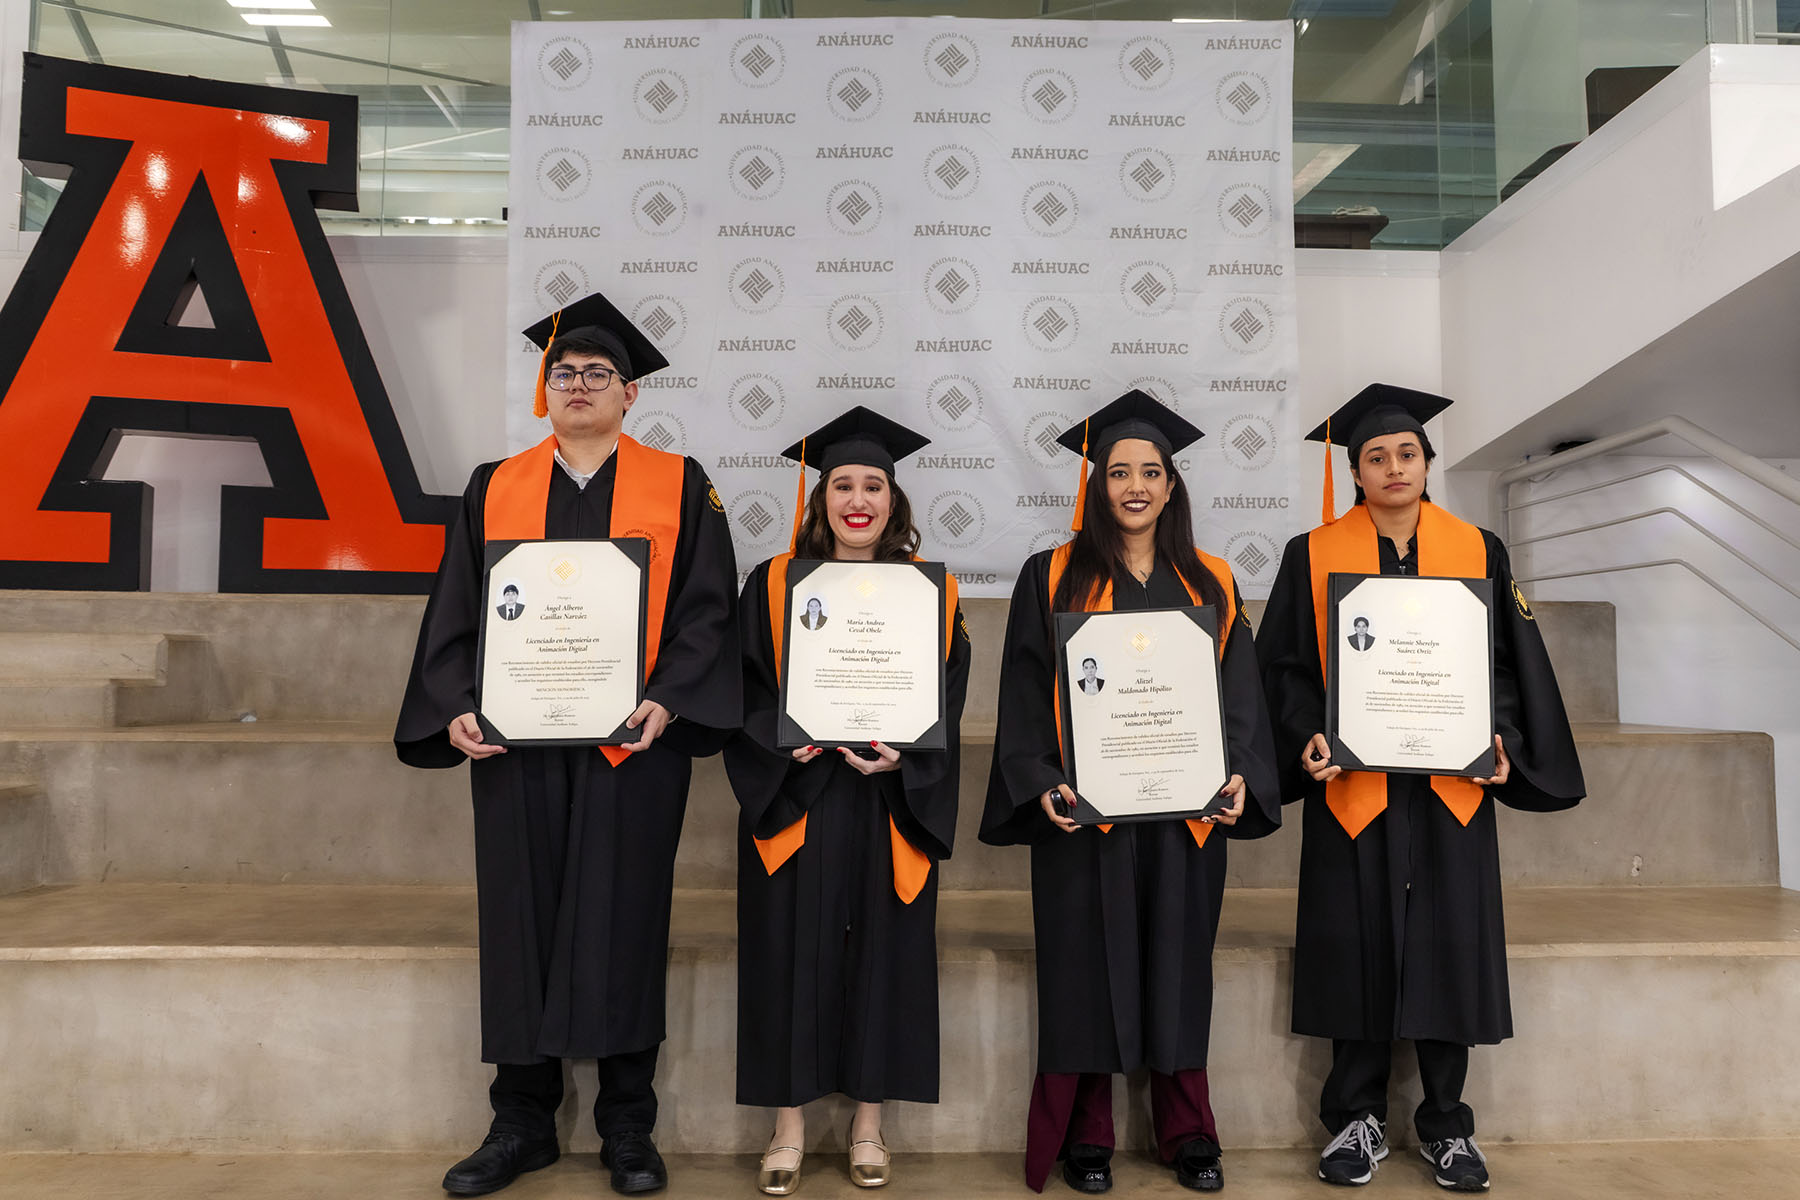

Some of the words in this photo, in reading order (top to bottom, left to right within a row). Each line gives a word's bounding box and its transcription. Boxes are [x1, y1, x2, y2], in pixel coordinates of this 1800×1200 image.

[622, 34, 700, 50] ANÁHUAC
[816, 32, 894, 46] ANÁHUAC
[1010, 32, 1088, 48] ANÁHUAC
[1204, 36, 1282, 50] ANÁHUAC
[526, 112, 602, 128] ANÁHUAC
[718, 110, 796, 124] ANÁHUAC
[912, 108, 990, 124] ANÁHUAC
[1108, 112, 1186, 128] ANÁHUAC
[622, 146, 698, 160] ANÁHUAC
[816, 144, 894, 158] ANÁHUAC
[1010, 144, 1088, 160] ANÁHUAC
[1206, 146, 1280, 164] ANÁHUAC
[523, 224, 602, 240] ANÁHUAC
[718, 222, 796, 238] ANÁHUAC
[914, 220, 992, 236] ANÁHUAC
[1110, 224, 1188, 240] ANÁHUAC
[620, 258, 698, 274] ANÁHUAC
[816, 258, 894, 272] ANÁHUAC
[1010, 258, 1090, 274] ANÁHUAC
[1208, 260, 1284, 276] ANÁHUAC
[0, 53, 455, 593] A
[718, 336, 796, 352] ANÁHUAC
[914, 336, 992, 352] ANÁHUAC
[1110, 338, 1188, 354] ANÁHUAC
[816, 372, 896, 390] ANÁHUAC
[1012, 376, 1090, 390] ANÁHUAC
[1210, 376, 1286, 392] ANÁHUAC
[717, 452, 796, 468] ANÁHUAC
[916, 454, 994, 470] ANÁHUAC
[1212, 492, 1288, 510] ANÁHUAC
[952, 572, 996, 584] HUAC
[564, 636, 592, 644] Ingeniería
[568, 645, 588, 653] Digital
[1111, 711, 1139, 719] Licenciado
[1148, 709, 1175, 718] Ingeniería
[1154, 718, 1172, 726] Digital
